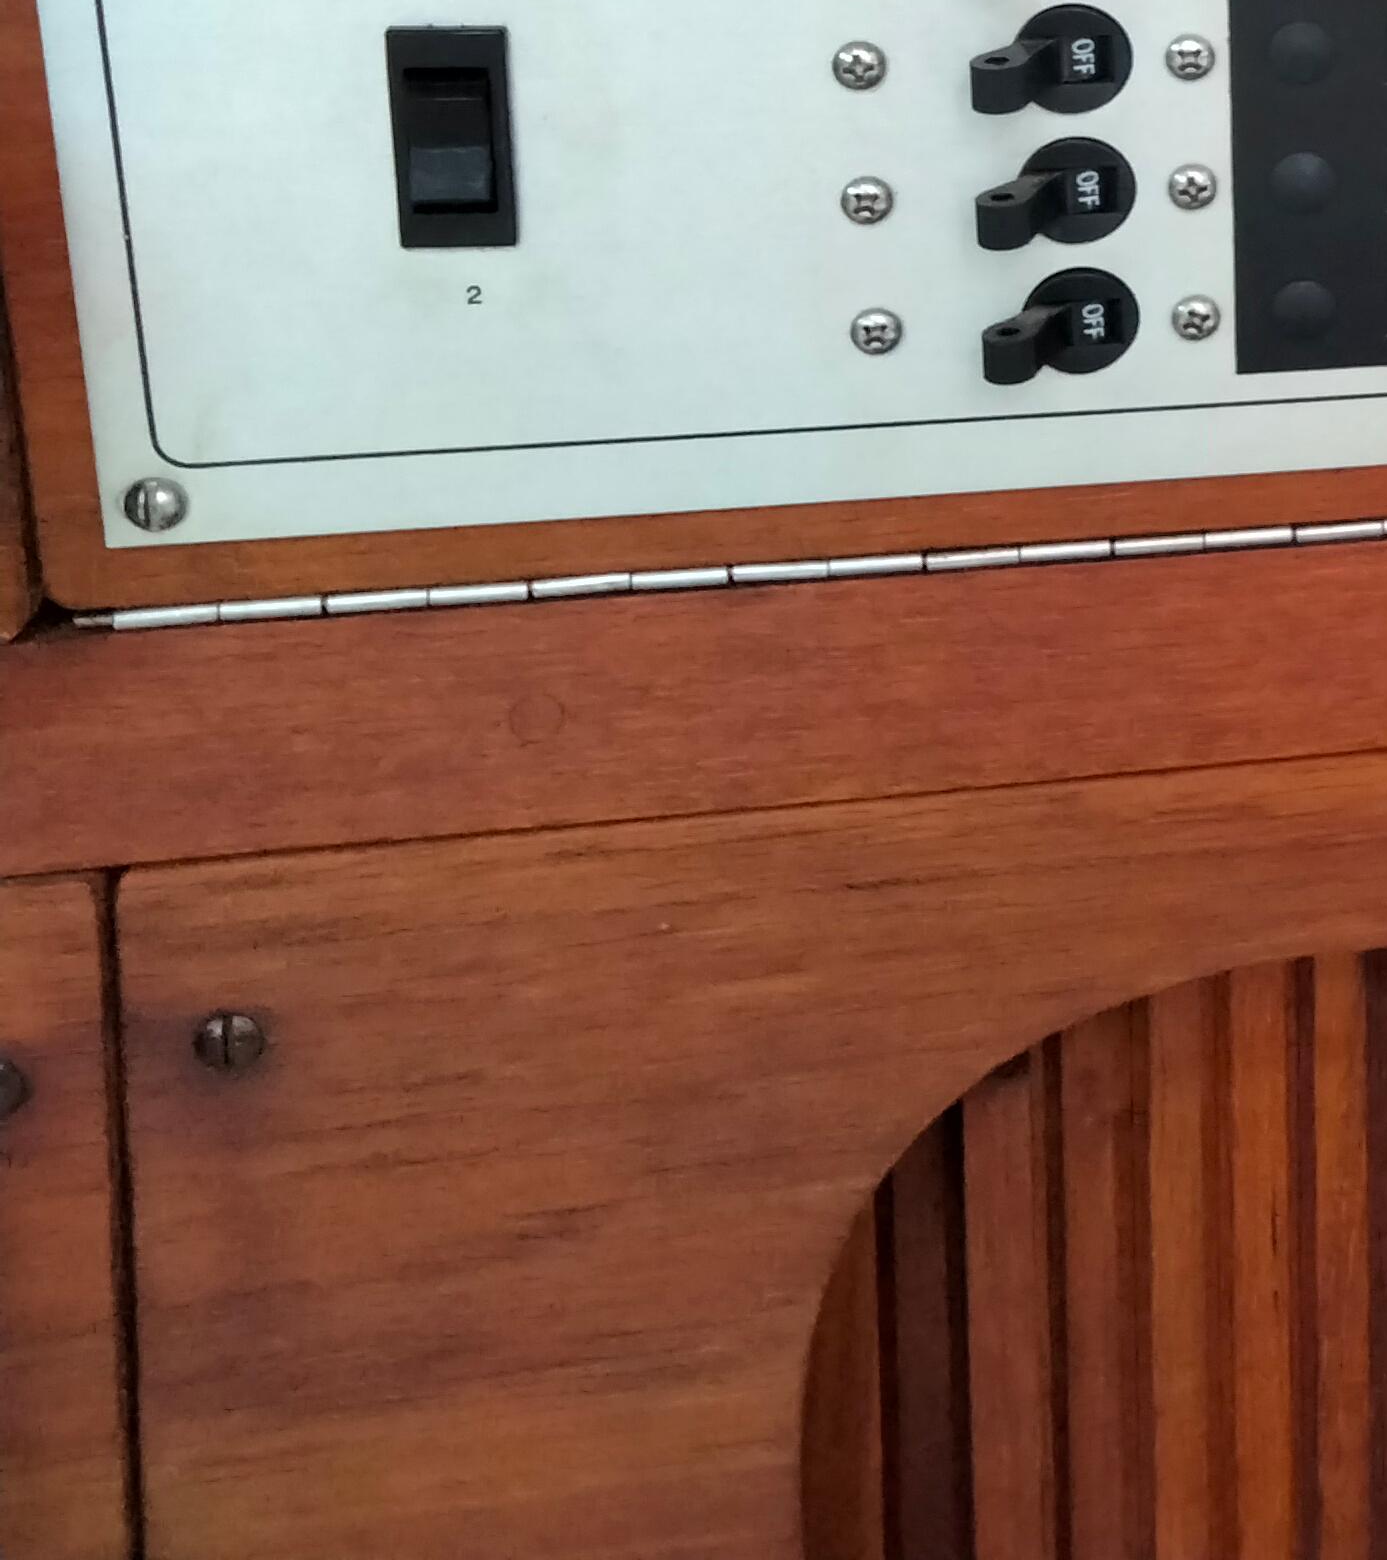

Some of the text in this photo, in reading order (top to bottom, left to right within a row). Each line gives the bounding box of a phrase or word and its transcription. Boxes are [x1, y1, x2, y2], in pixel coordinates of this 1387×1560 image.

[1071, 38, 1096, 77] OFF
[1075, 170, 1101, 208] OFF
[466, 285, 483, 305] 2
[1081, 303, 1106, 341] OFF
